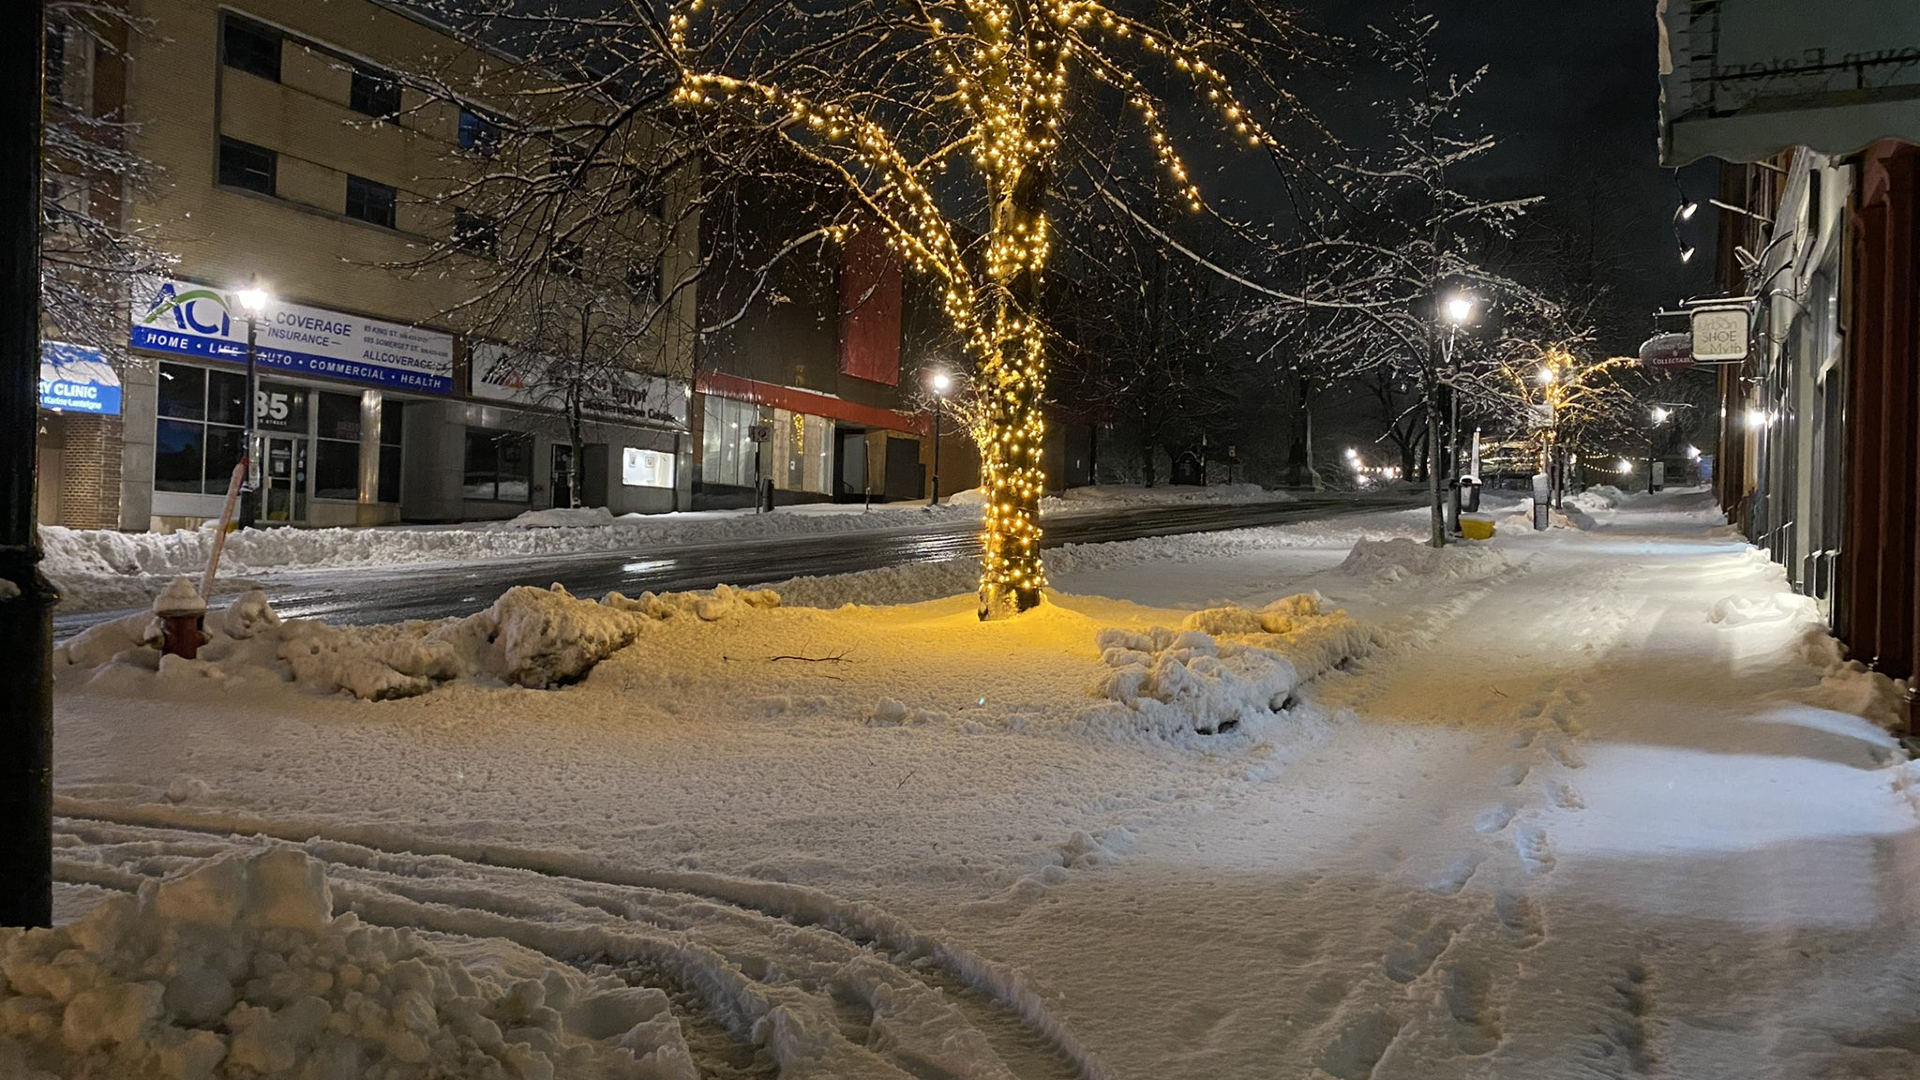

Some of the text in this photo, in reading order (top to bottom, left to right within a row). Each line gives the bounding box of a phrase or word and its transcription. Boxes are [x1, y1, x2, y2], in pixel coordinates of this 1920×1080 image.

[276, 312, 352, 337] COVERAGE
[372, 326, 388, 335] KING
[267, 327, 329, 347] INSURANCE
[375, 338, 409, 350] SOMERSET
[1701, 330, 1737, 343] SHOE
[1709, 343, 1742, 355] Myth
[146, 333, 188, 349] HOME
[209, 343, 239, 356] LIFE
[309, 359, 385, 380] COMMERCIAL
[400, 374, 442, 388] HEALTH
[54, 383, 98, 399] CLINIC
[257, 391, 289, 420] 85
